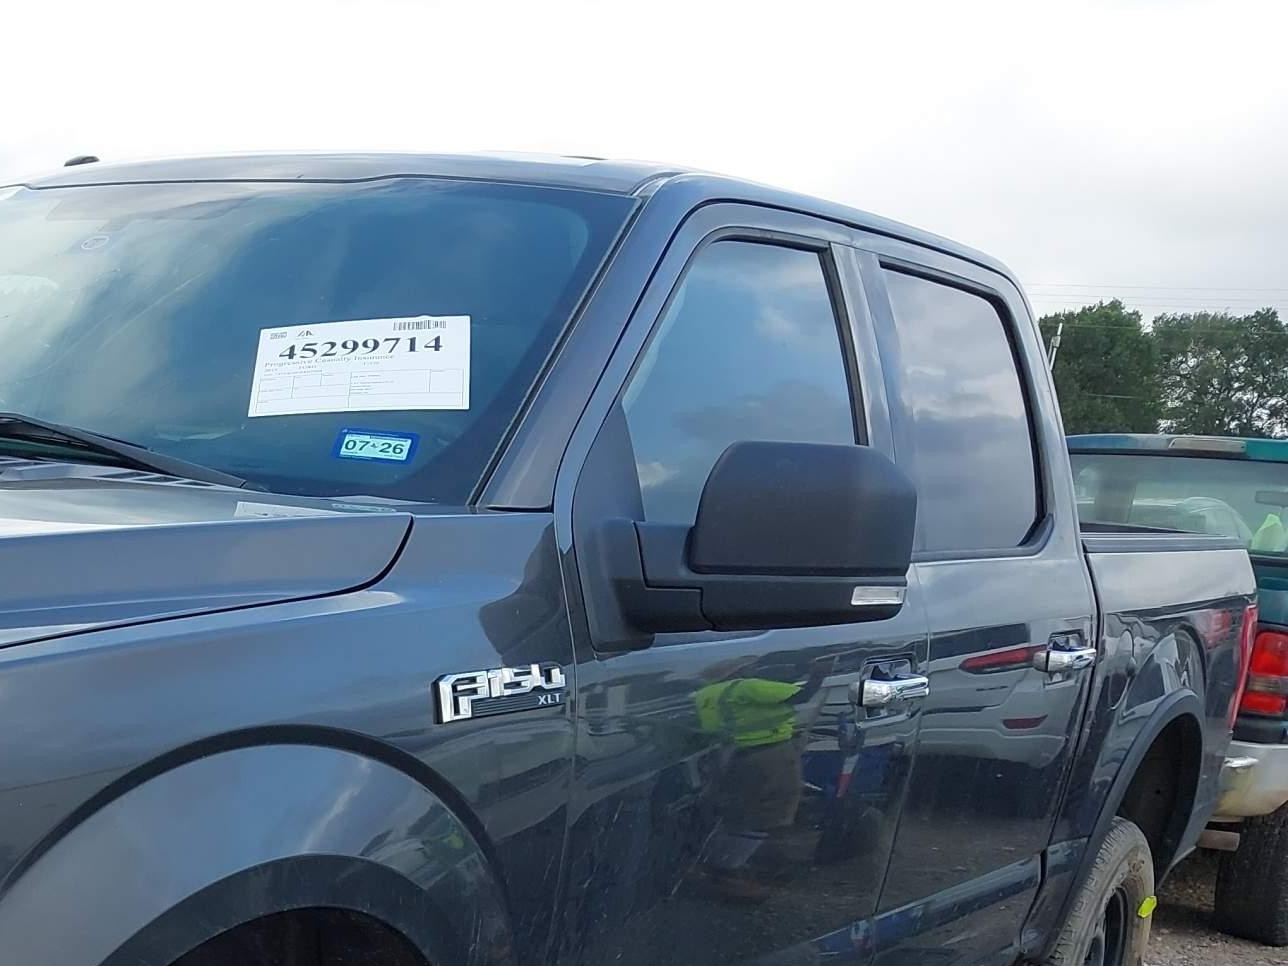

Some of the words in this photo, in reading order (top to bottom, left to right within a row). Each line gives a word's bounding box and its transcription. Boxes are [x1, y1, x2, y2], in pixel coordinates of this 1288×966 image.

[278, 335, 443, 360] 45299714
[344, 439, 370, 451] 07
[379, 442, 405, 455] 26
[538, 693, 560, 705] XLT
